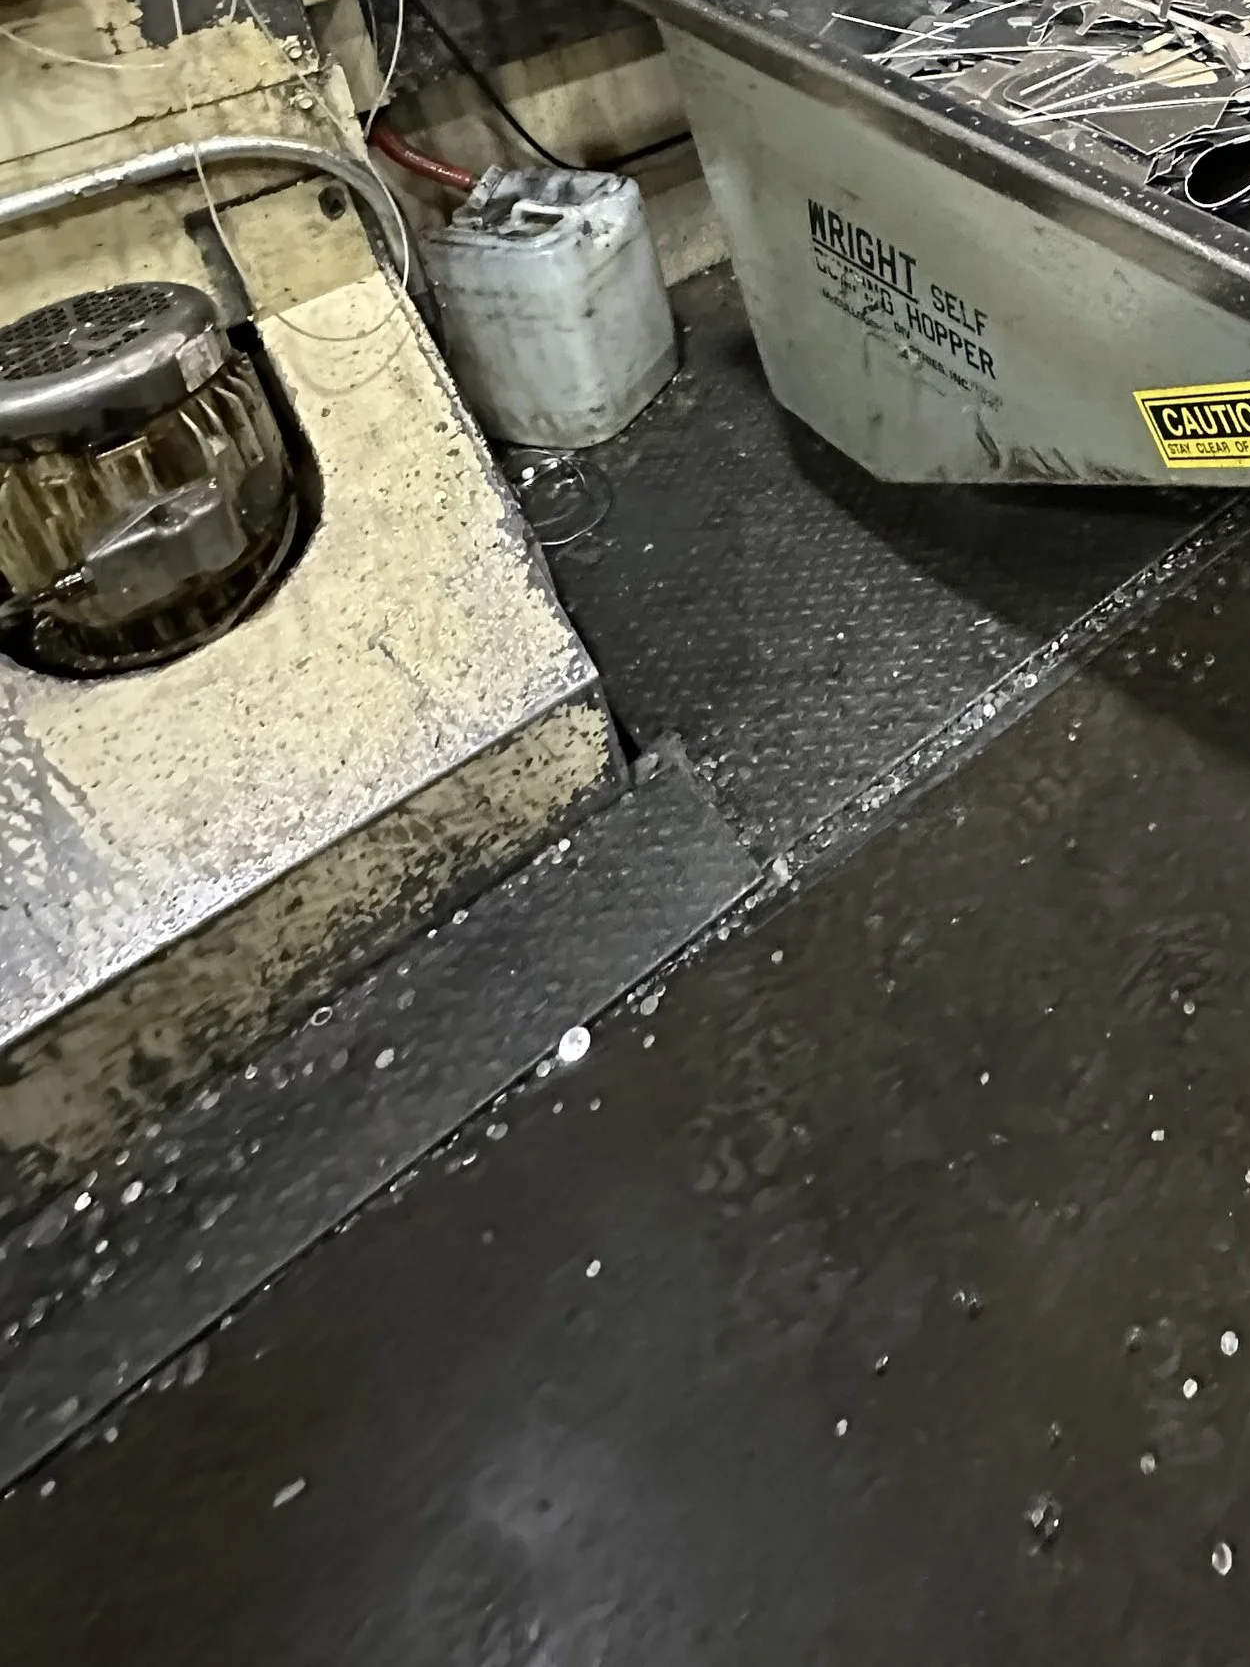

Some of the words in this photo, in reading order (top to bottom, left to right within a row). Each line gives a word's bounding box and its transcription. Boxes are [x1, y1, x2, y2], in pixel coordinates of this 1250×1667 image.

[808, 199, 917, 295] WRIGHT
[931, 283, 988, 337] SELF
[906, 302, 997, 380] HOPPER
[1167, 442, 1191, 455] STAY
[1195, 440, 1231, 454] CLEAR
[1234, 440, 1250, 453] OF
